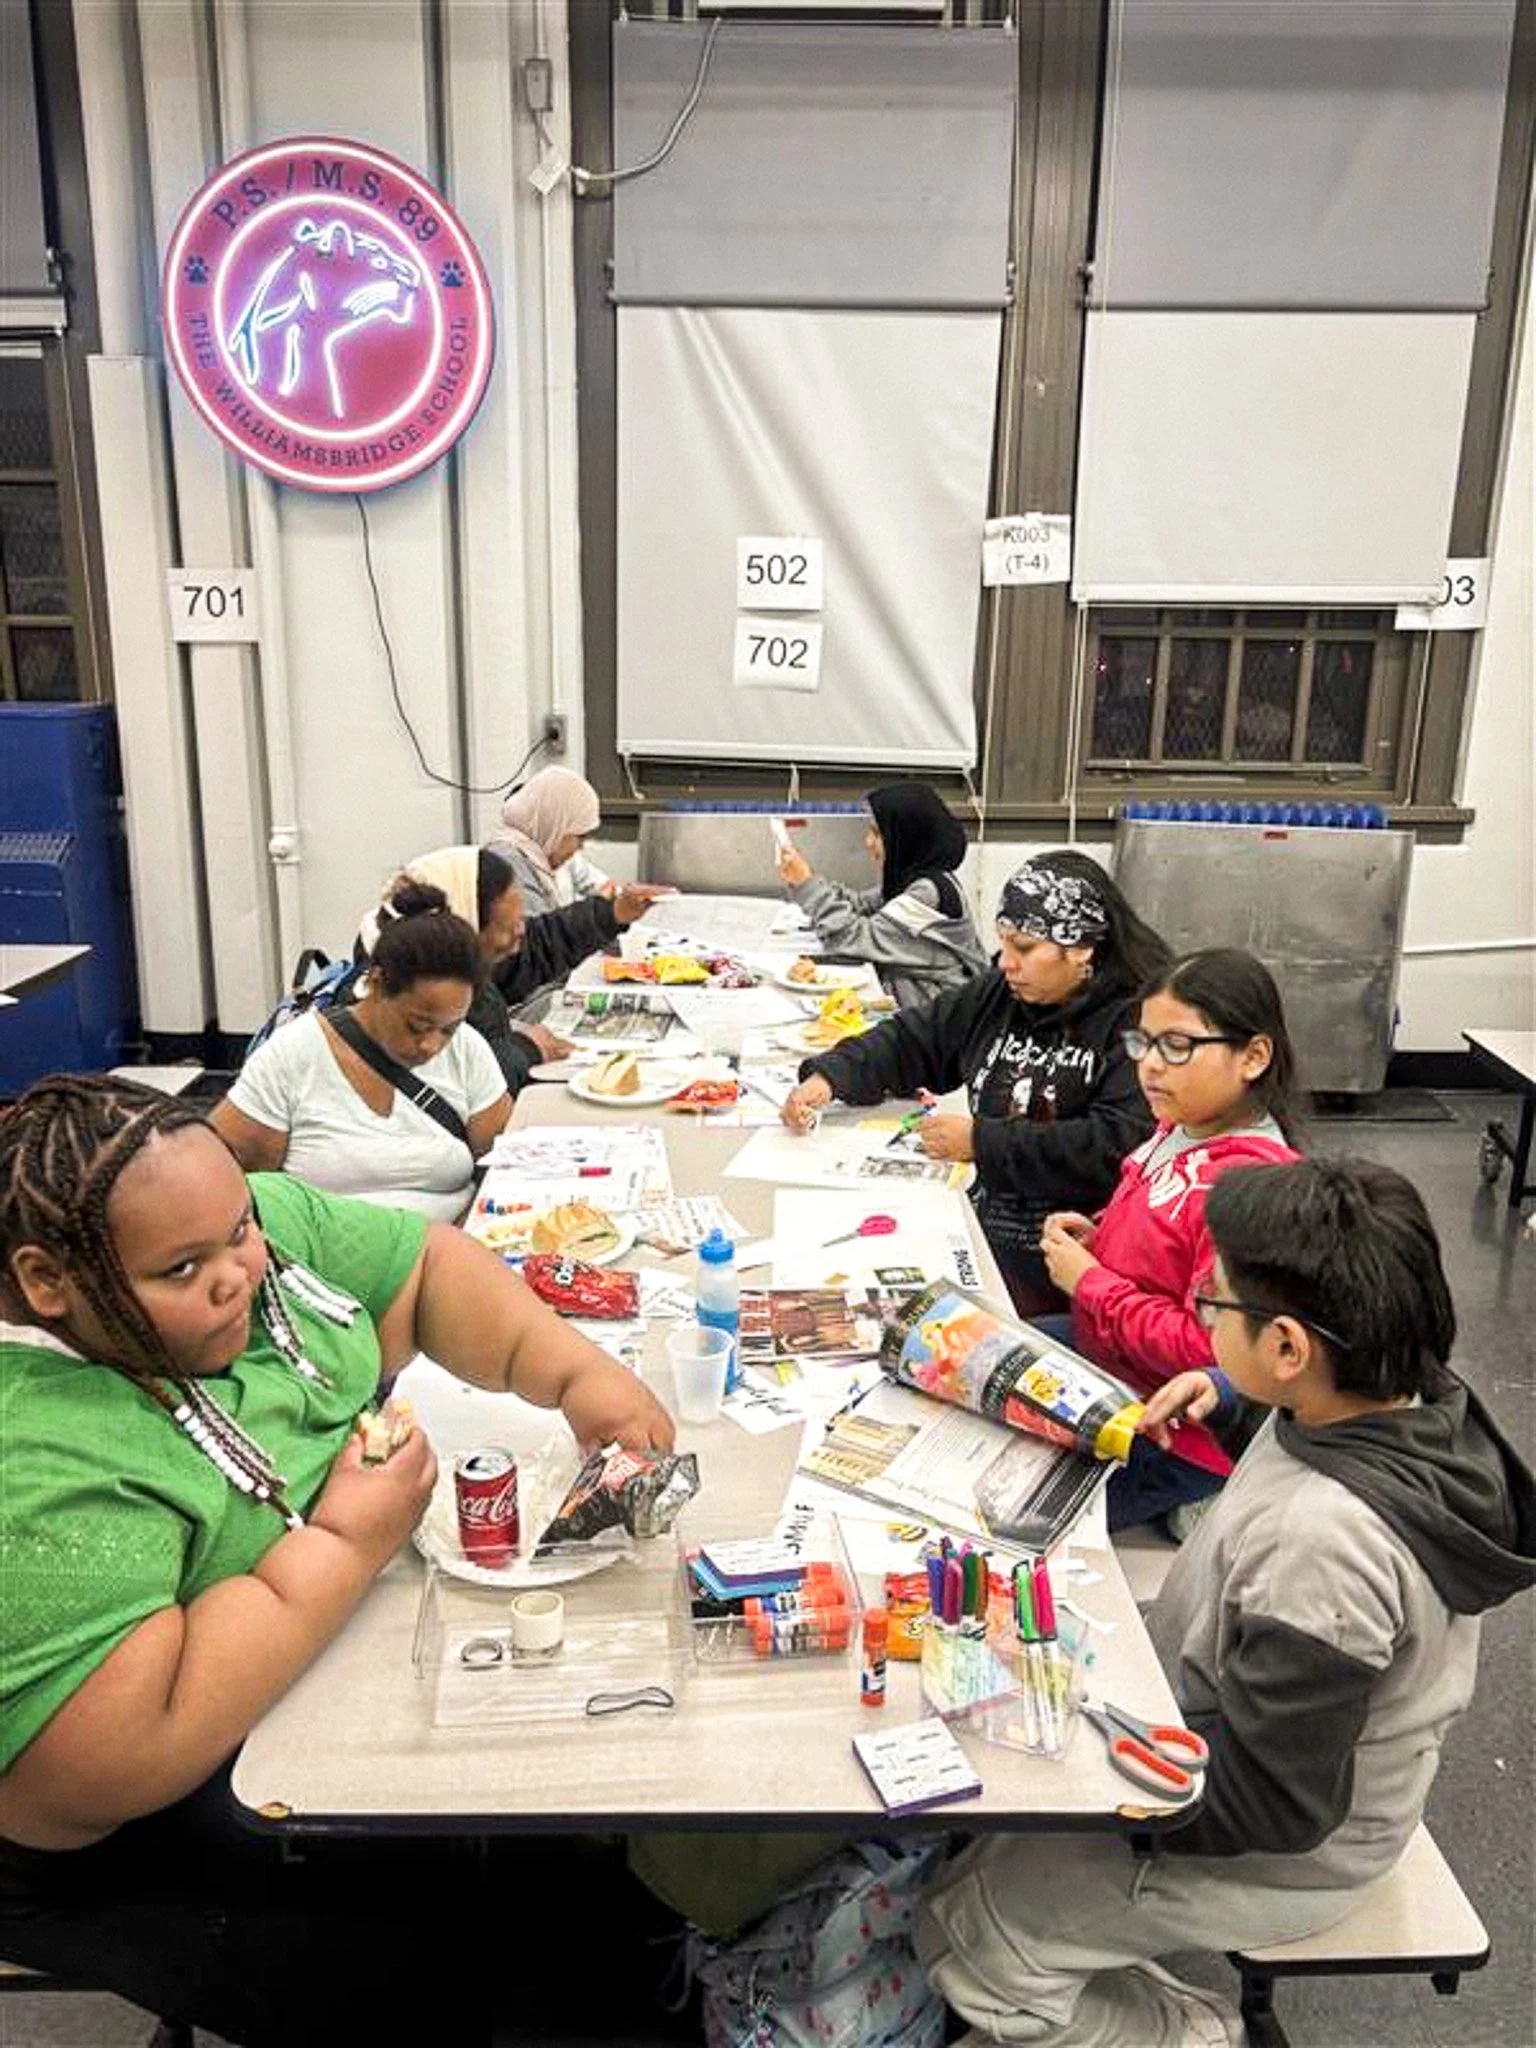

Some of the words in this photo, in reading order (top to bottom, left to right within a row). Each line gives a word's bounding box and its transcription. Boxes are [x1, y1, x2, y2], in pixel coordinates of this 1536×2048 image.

[399, 196, 438, 242] 89
[185, 312, 217, 370] THE
[216, 379, 422, 467] WILLIAMSBRIDGE
[421, 316, 468, 426] SCHOOL
[746, 554, 808, 585] 502
[183, 585, 244, 618] 701
[748, 634, 808, 669] 702
